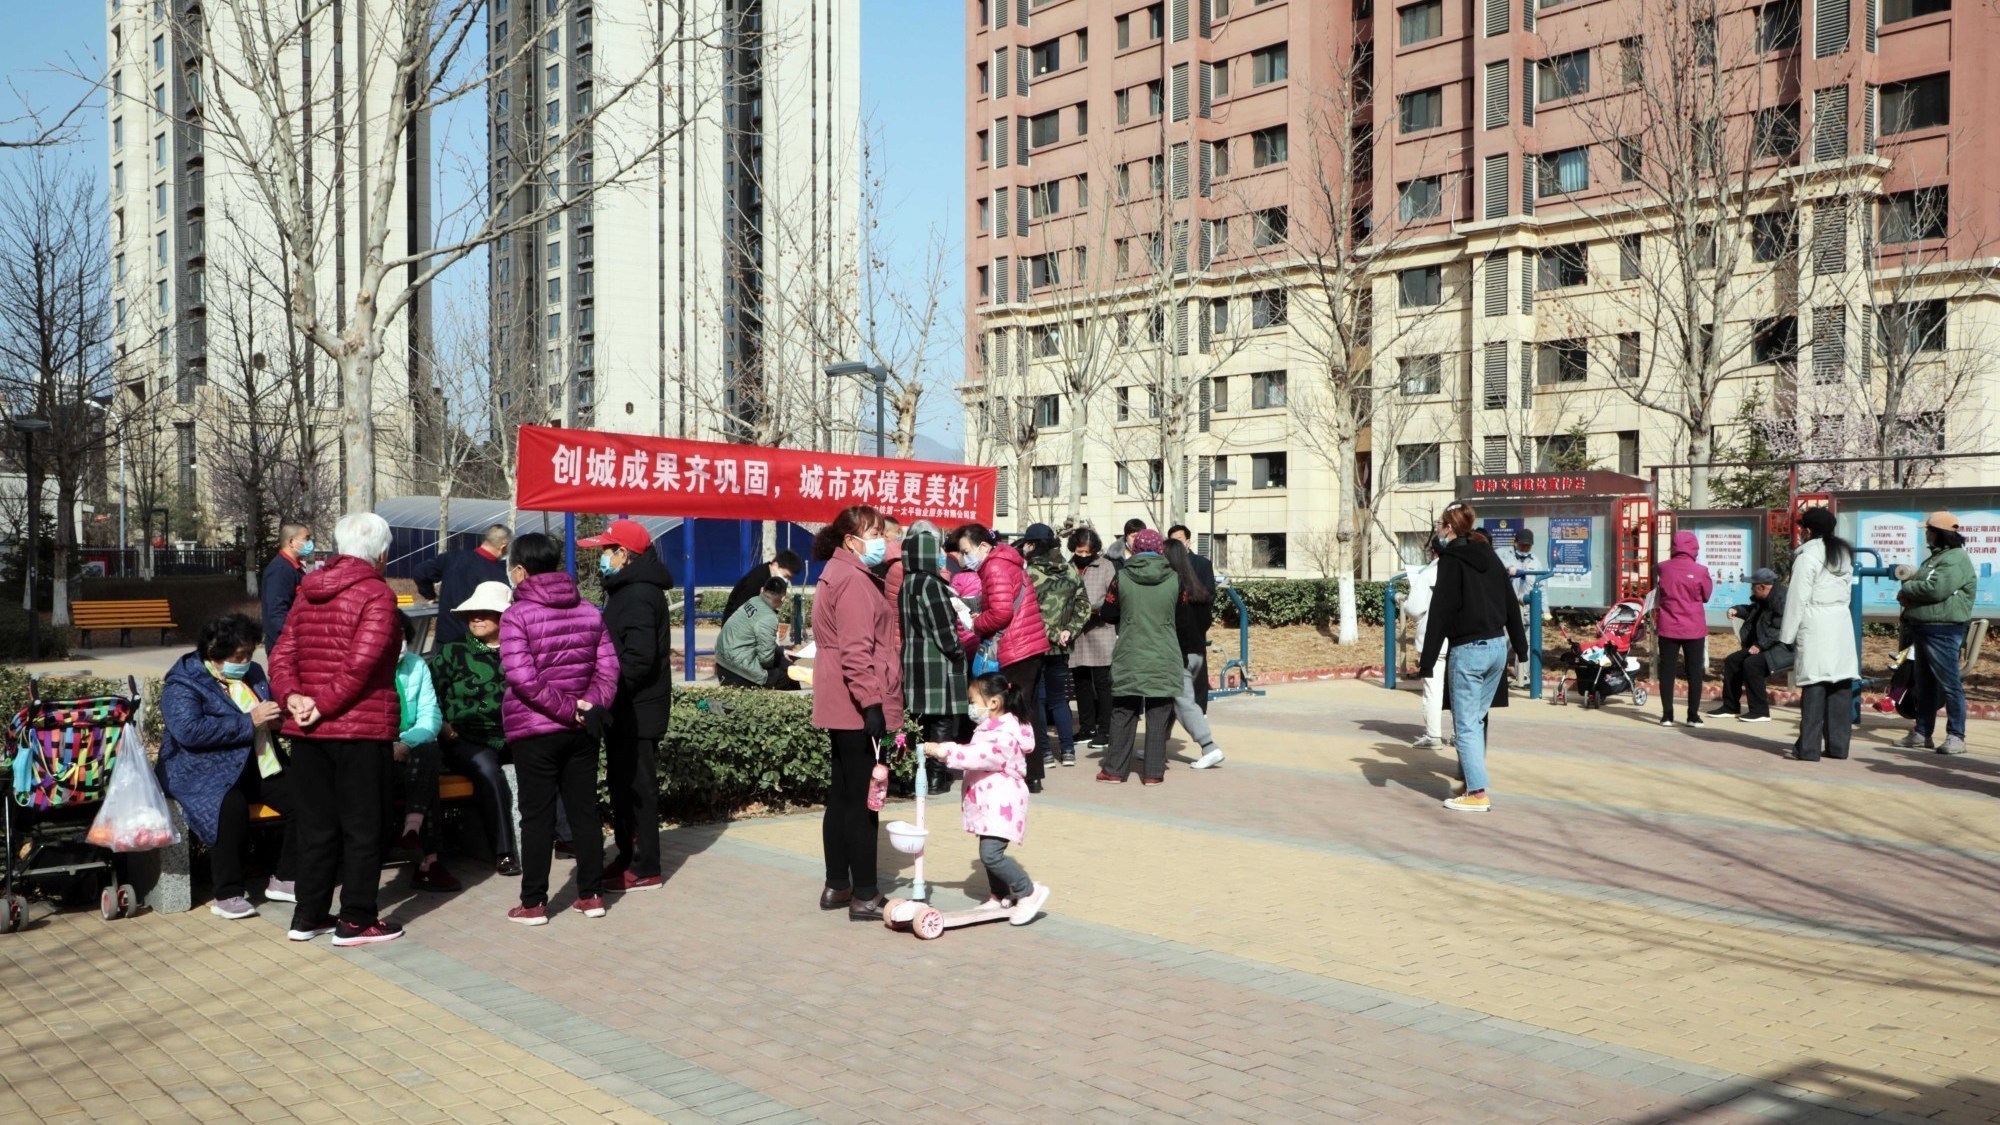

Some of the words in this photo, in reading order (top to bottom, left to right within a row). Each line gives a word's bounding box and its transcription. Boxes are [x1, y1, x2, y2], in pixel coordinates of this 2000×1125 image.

[1474, 477, 1586, 492] 精神文明建设宣传栏
